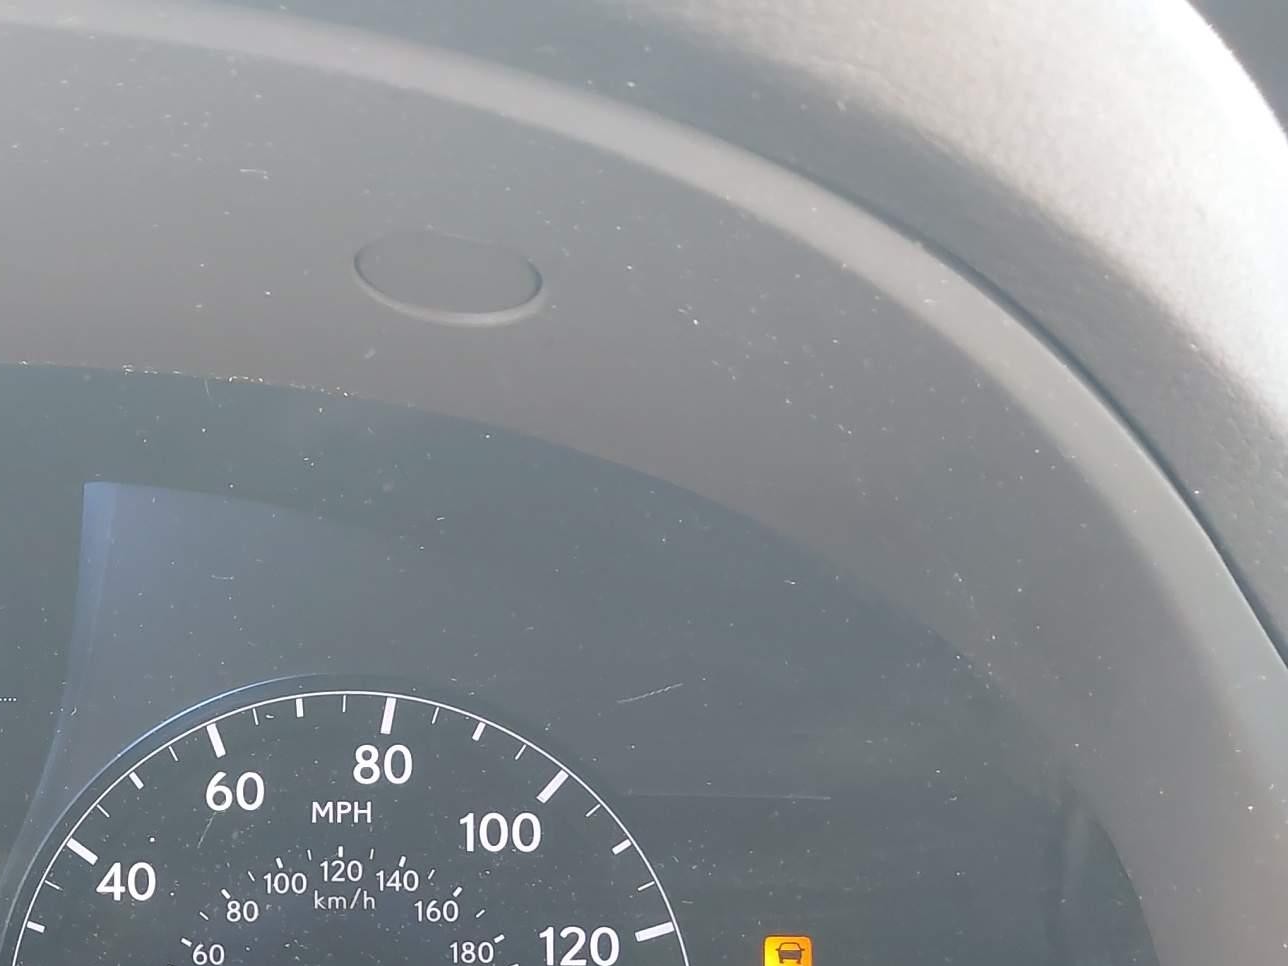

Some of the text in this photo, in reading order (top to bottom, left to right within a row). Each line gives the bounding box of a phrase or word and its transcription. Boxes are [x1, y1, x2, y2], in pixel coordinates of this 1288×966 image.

[352, 744, 413, 785] 80
[206, 771, 265, 811] 60
[311, 801, 373, 825] MPH
[460, 812, 541, 853] 100
[97, 862, 156, 901] 40
[263, 872, 307, 896] 100
[320, 860, 363, 884] 120
[376, 869, 419, 893] 140
[226, 900, 259, 924] 80
[313, 889, 375, 912] km/h
[414, 900, 459, 923] 160
[193, 944, 225, 966] 60
[450, 941, 494, 965] 180
[539, 926, 619, 966] 120
